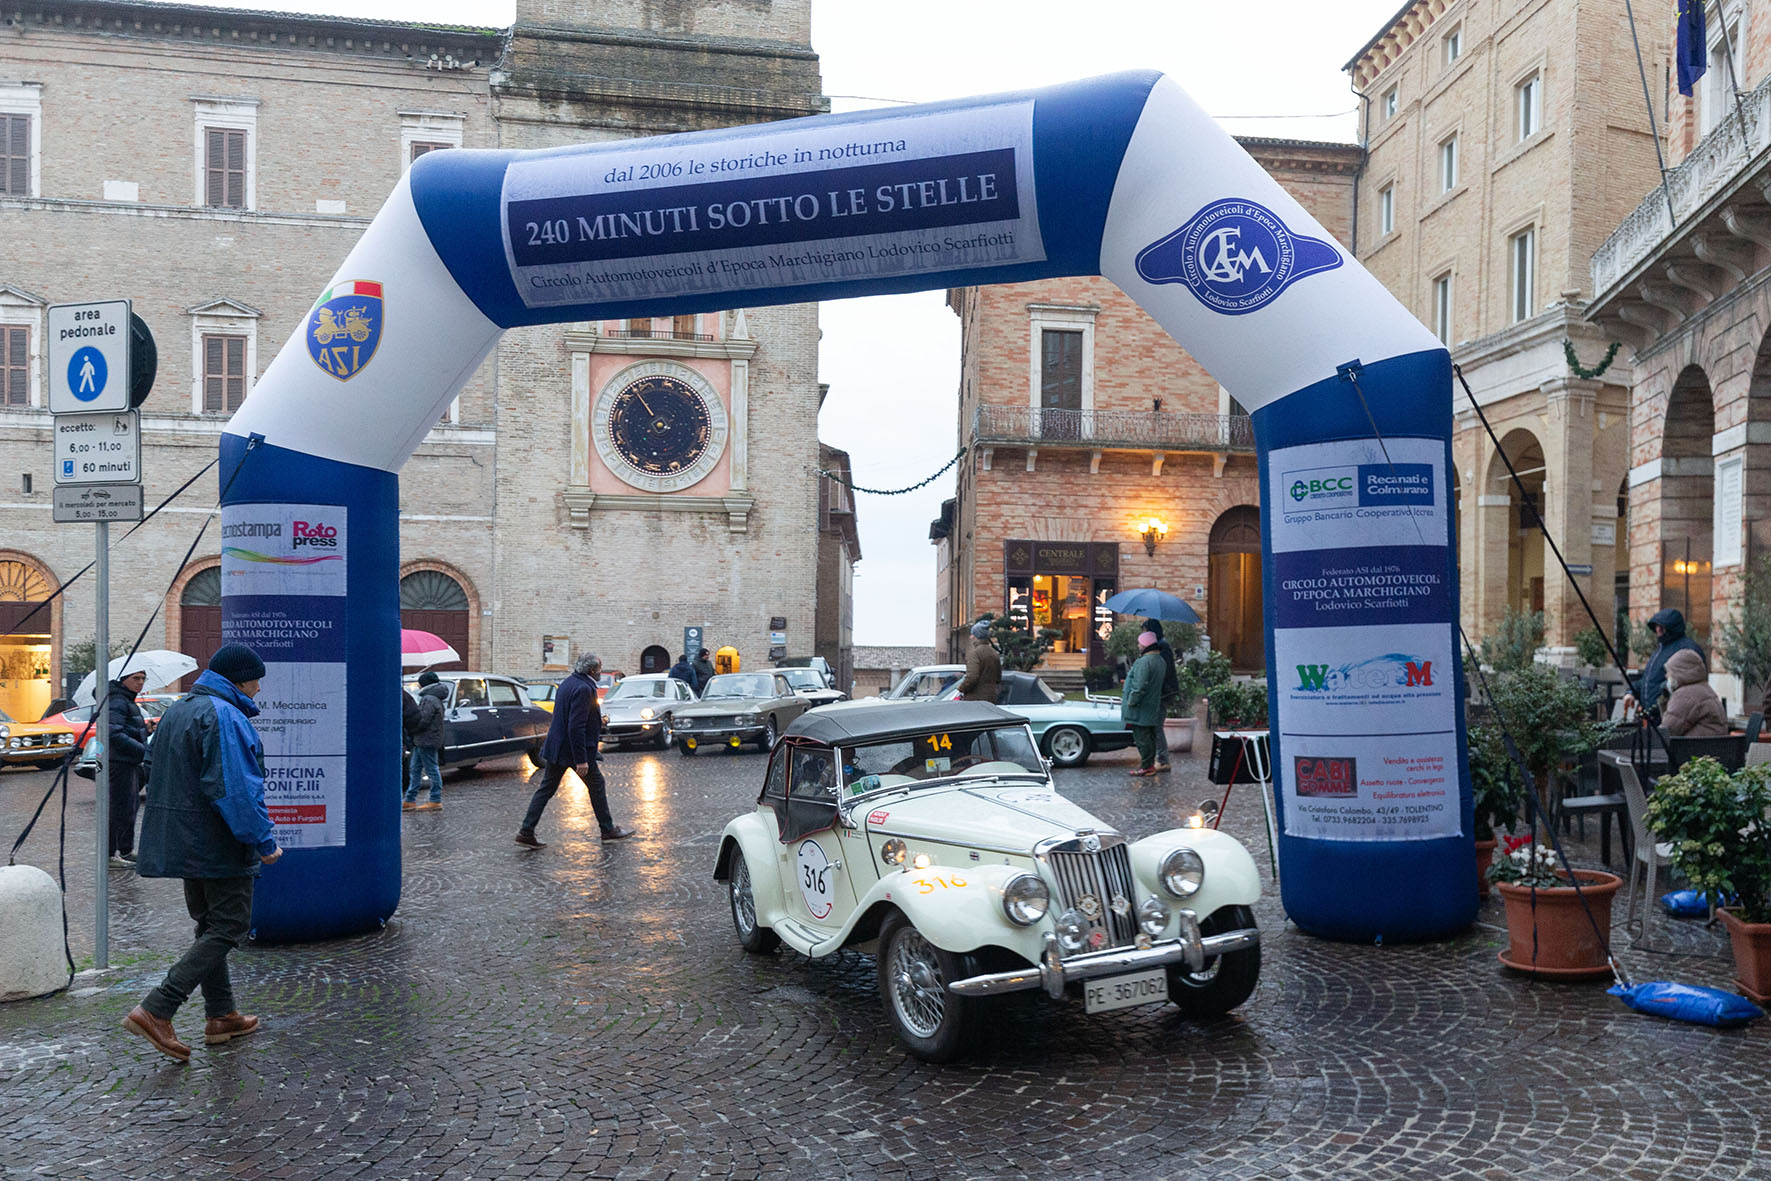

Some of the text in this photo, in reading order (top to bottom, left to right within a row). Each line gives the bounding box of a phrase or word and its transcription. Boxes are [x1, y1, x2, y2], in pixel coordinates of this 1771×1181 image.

[604, 139, 907, 184] dal 2006 le storiche in notturna
[526, 173, 999, 246] 240 MINUTI SOTTO LE STELLE
[1184, 205, 1292, 287] Circolo Automotoveicoli d'Epoca Marchigiano
[530, 231, 1016, 289] Circolo Automotoveicoli d'Epoca Marchigiano Lodovico Scarfiotti
[1203, 286, 1274, 308] Lodovico Scarfiotti
[74, 309, 101, 321] area
[60, 323, 116, 341] pedonale
[60, 422, 97, 433] eccetto:
[83, 461, 132, 473] 60 minuti
[1310, 477, 1353, 493] BCC
[1367, 474, 1428, 485] Recanati e
[1367, 485, 1429, 495] Colmurano
[1284, 515, 1312, 525] Gruppo
[1315, 510, 1353, 521] Bancario
[1356, 508, 1411, 519] Cooperativo
[293, 521, 337, 539] Roto
[293, 536, 337, 550] press
[1039, 549, 1086, 559] CENTRALE
[1321, 568, 1354, 576] Federato
[1355, 567, 1369, 575] ASI
[1370, 566, 1383, 574] dal
[1282, 578, 1327, 590] CIRCOLO
[1293, 585, 1431, 601] D'EPOCA MARCHIGIANO
[1315, 598, 1409, 611] Lodovico Scarfiotti
[235, 620, 333, 629] AUTOMOTOVEICOLI
[242, 629, 319, 639] MARCHIGIANO
[255, 639, 294, 648] Scarfiotti
[272, 701, 328, 710] Meccanica
[927, 733, 953, 752] 14
[264, 767, 325, 779] OFFICINA
[1297, 758, 1351, 780] CABI
[1298, 780, 1352, 794] GOMME
[1298, 804, 1307, 812] Via
[1376, 806, 1400, 815] 43/49
[1405, 803, 1444, 813] TOLENTINO
[297, 814, 324, 823] Furgoni
[803, 864, 826, 895] 316
[911, 873, 968, 895] 316
[1088, 976, 1166, 1006] PE 367062
